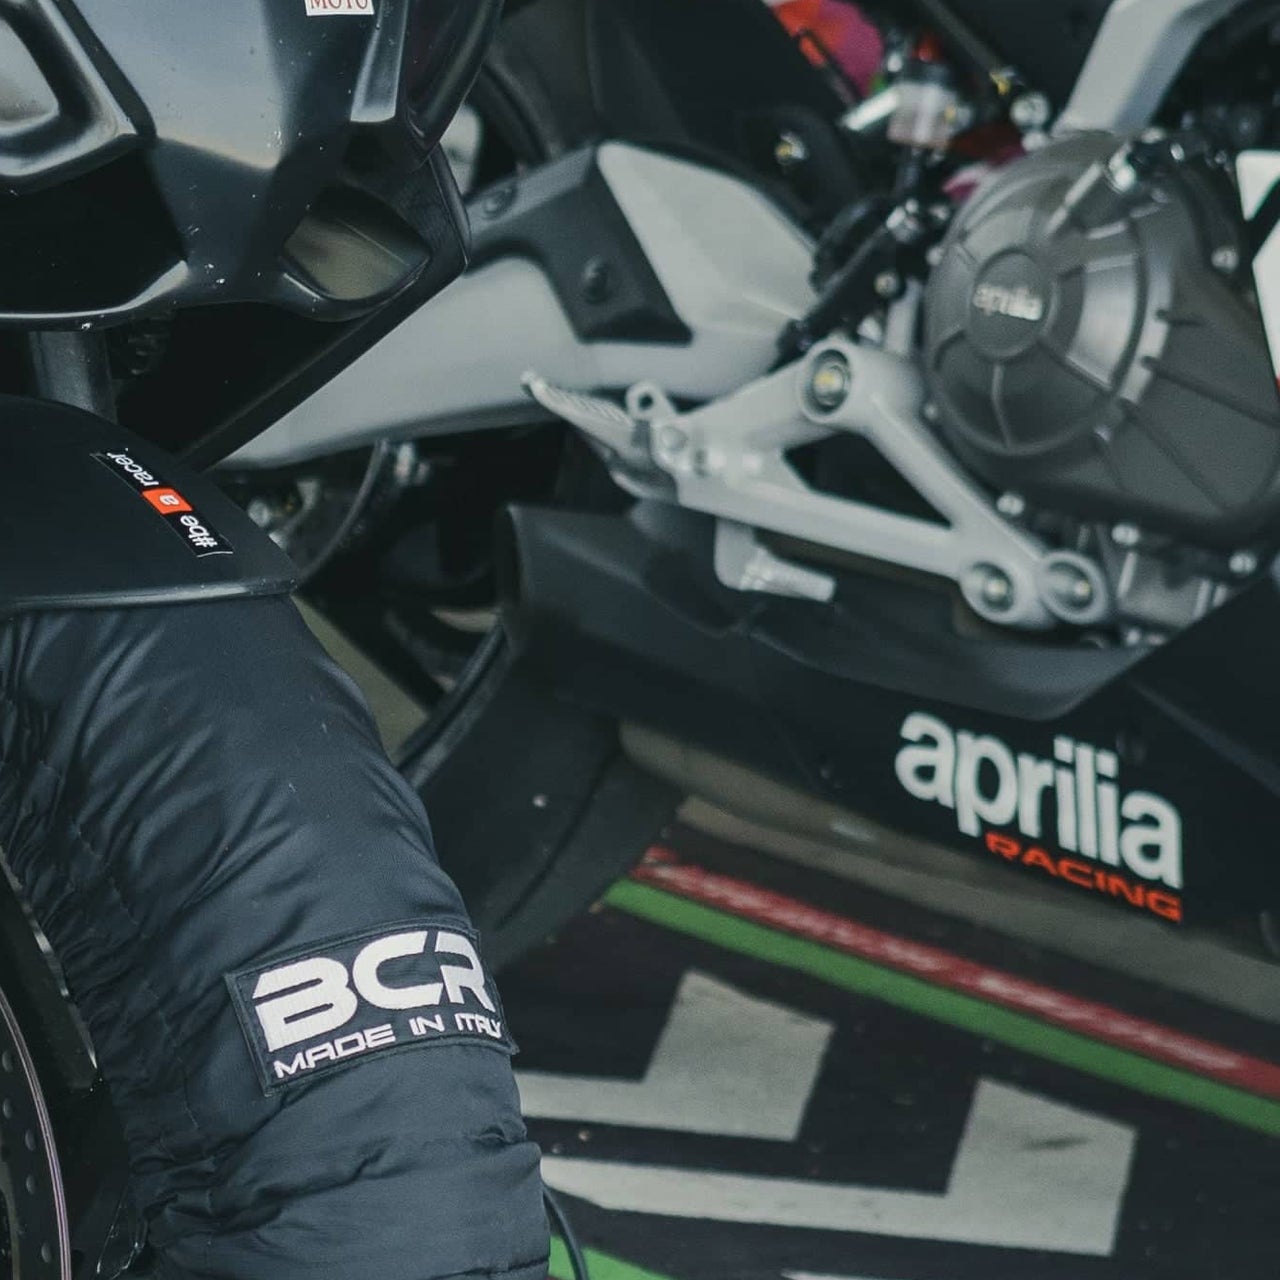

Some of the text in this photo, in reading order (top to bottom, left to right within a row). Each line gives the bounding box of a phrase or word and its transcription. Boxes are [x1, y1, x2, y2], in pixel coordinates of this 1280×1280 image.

[180, 515, 218, 548] #be
[894, 711, 1183, 890] aprilia
[984, 831, 1182, 921] RACING
[252, 930, 496, 1053] BCR
[273, 1012, 502, 1078] MADE IN ITALY
